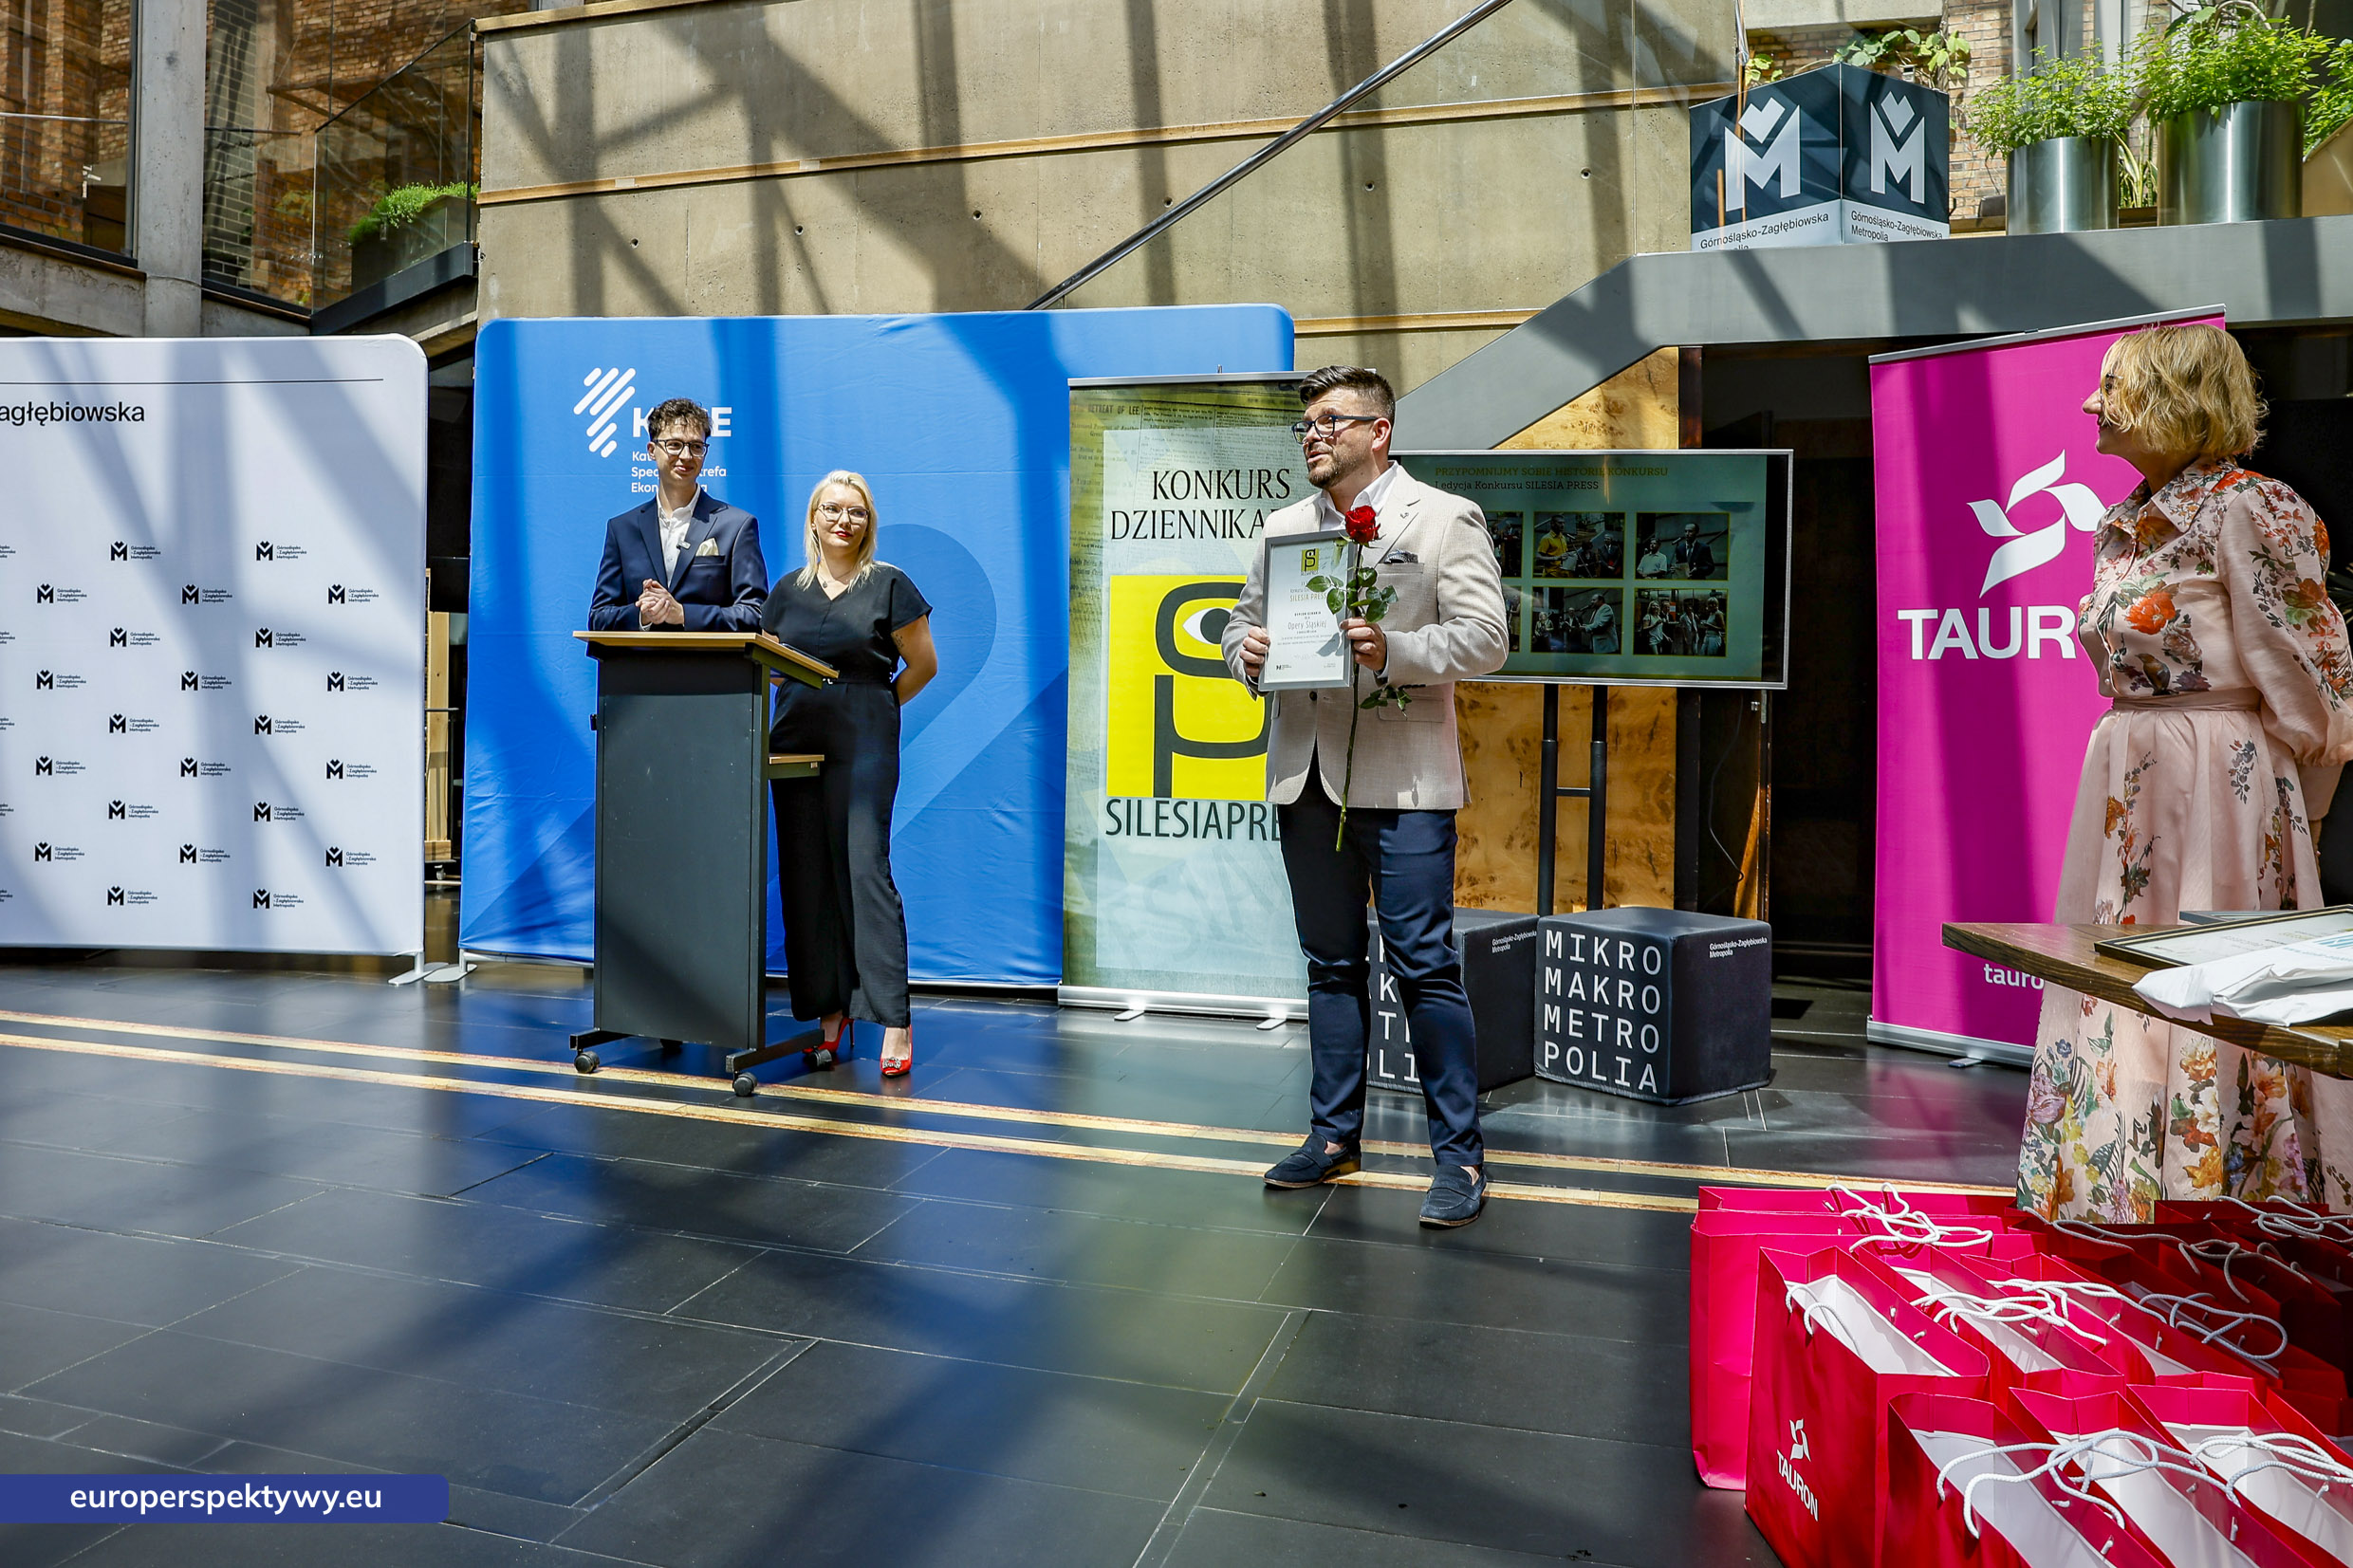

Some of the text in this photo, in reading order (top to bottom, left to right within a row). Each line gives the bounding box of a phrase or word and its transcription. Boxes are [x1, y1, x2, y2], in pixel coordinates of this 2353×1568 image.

[1700, 212, 1829, 249] Górnośląsko-Zagłębiowska
[1851, 211, 1943, 240] Górnośląsko-Zagłębiowska
[1852, 225, 1889, 241] Metropolia
[1152, 468, 1290, 500] KONKURS
[1435, 467, 1518, 476] PRZYPOMNIJMY
[1521, 467, 1551, 476] SOBIE
[1608, 467, 1668, 476] KONKURSU
[1441, 481, 1472, 491] edycja
[1475, 481, 1522, 489] Konkursu
[1525, 481, 1564, 489] SILESIA
[1567, 481, 1599, 489] PRESS
[1111, 508, 1280, 540] DZIENNIKA
[1898, 606, 2076, 660] TAUR
[1106, 799, 1280, 841] SILESIAPRE
[1546, 929, 1661, 975] MIKRO
[1545, 967, 1661, 1015] MAKRO
[1544, 1004, 1660, 1054] METRO
[1544, 1041, 1658, 1094] POLIA
[1777, 1449, 1818, 1522] TAURON
